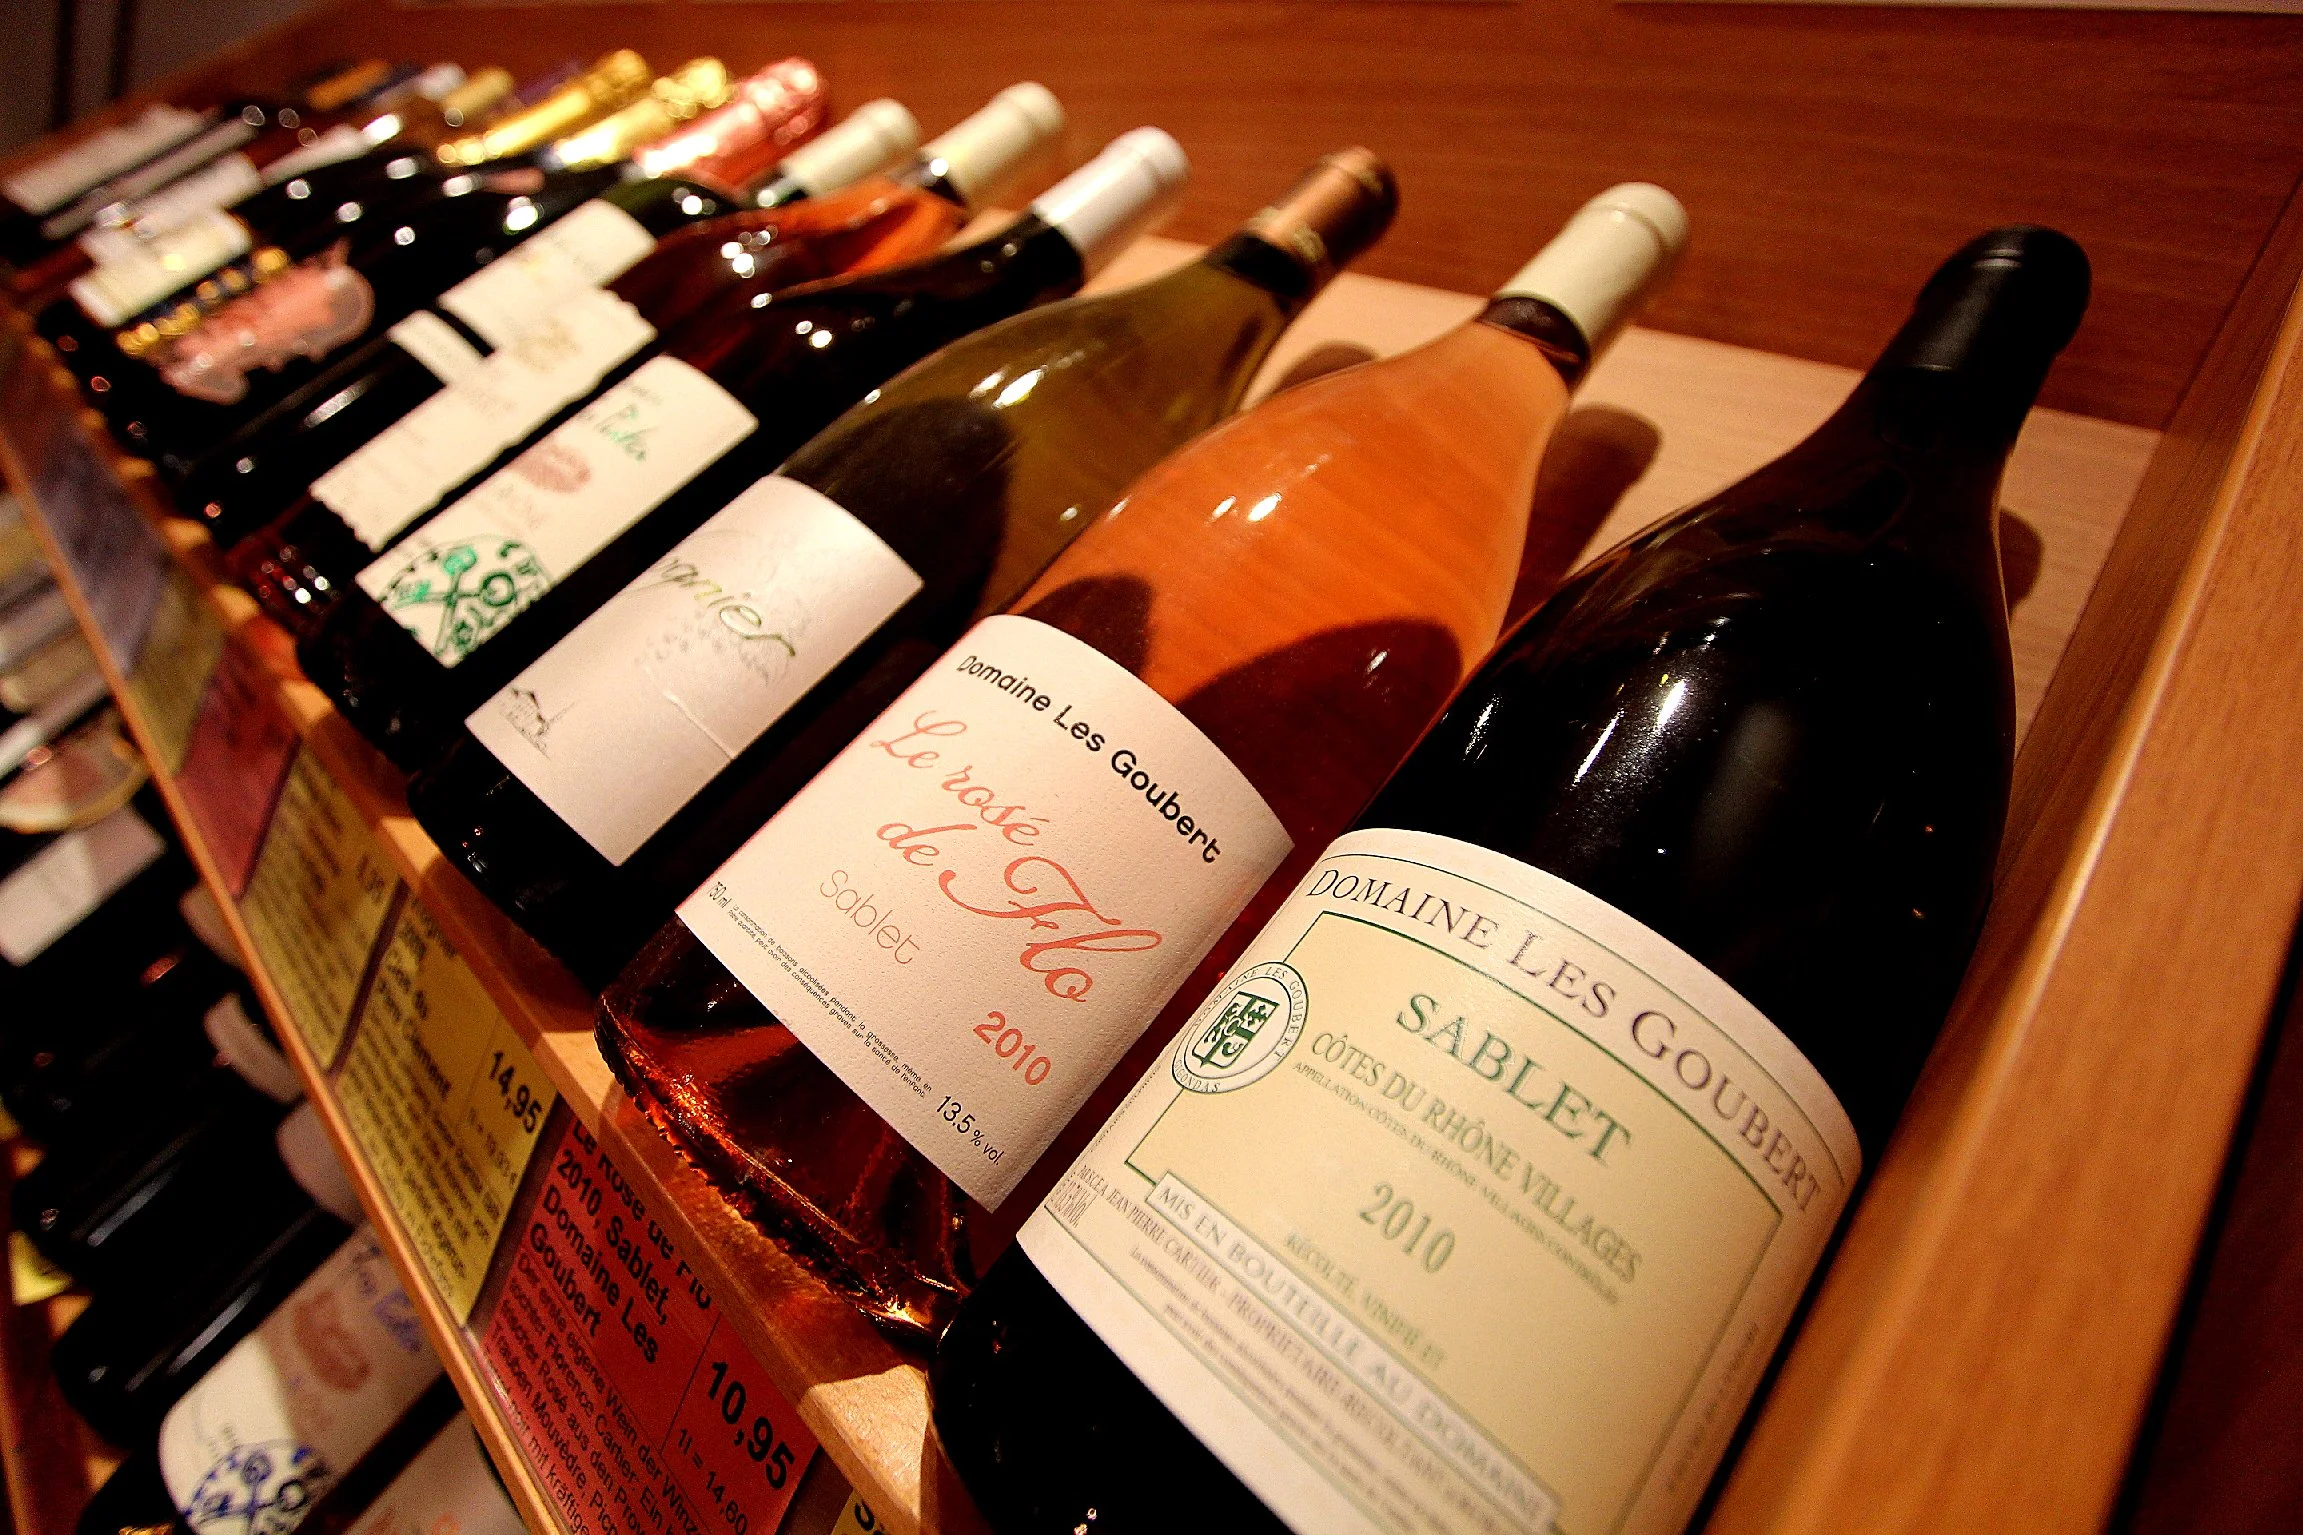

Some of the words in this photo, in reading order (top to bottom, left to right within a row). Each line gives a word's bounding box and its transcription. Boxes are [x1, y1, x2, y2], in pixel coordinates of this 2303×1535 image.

[869, 710, 968, 769] Le
[941, 765, 1049, 845] rosé
[957, 655, 1051, 711] Domaine
[1053, 704, 1105, 752] Les
[1111, 749, 1221, 864] Goubert
[820, 870, 920, 965] Sablet
[876, 823, 977, 866] de
[939, 856, 1162, 1003] Flo
[1264, 966, 1289, 980] LES
[776, 945, 799, 967] boissons
[799, 967, 830, 996] alcoolisées
[830, 997, 857, 1022] pendant
[858, 1021, 866, 1031] la
[923, 1082, 932, 1092] en
[791, 971, 830, 1009] conséquences
[829, 1007, 852, 1030] graves
[851, 1028, 864, 1039] sur
[871, 1046, 891, 1066] santé
[891, 1065, 901, 1075] de
[973, 1010, 1052, 1086] 2010
[1306, 869, 1499, 950] DOMAINE
[1507, 930, 1617, 1018] LES
[1631, 1010, 1821, 1213] GOUBERT
[1396, 993, 1633, 1168] SABLET
[489, 1052, 543, 1133] 14,95
[936, 1095, 976, 1134] 13.5
[970, 1129, 985, 1147] %
[1159, 1185, 1197, 1221] MIS
[1195, 1214, 1229, 1248] EN
[1312, 1032, 1386, 1087] CÔTES
[1381, 1071, 1427, 1112] DU
[1422, 1097, 1521, 1182] RHÔNE
[1519, 1161, 1644, 1284] VILLAGES
[530, 1223, 601, 1338] Goubert
[543, 1184, 620, 1307] Domaine
[620, 1295, 659, 1364] Les
[557, 1149, 602, 1230] 2010,
[606, 1215, 669, 1326] Sablet,
[1359, 1181, 1456, 1275] 2010
[545, 1332, 595, 1418] Florence
[640, 1485, 663, 1529] Ein
[567, 1413, 590, 1452] aus
[588, 1449, 614, 1493] den
[604, 1387, 638, 1447] Wein
[637, 1444, 663, 1482] der
[661, 1474, 701, 1535] Winz
[707, 1361, 796, 1491] 10,95
[545, 1463, 591, 1535] kräftige
